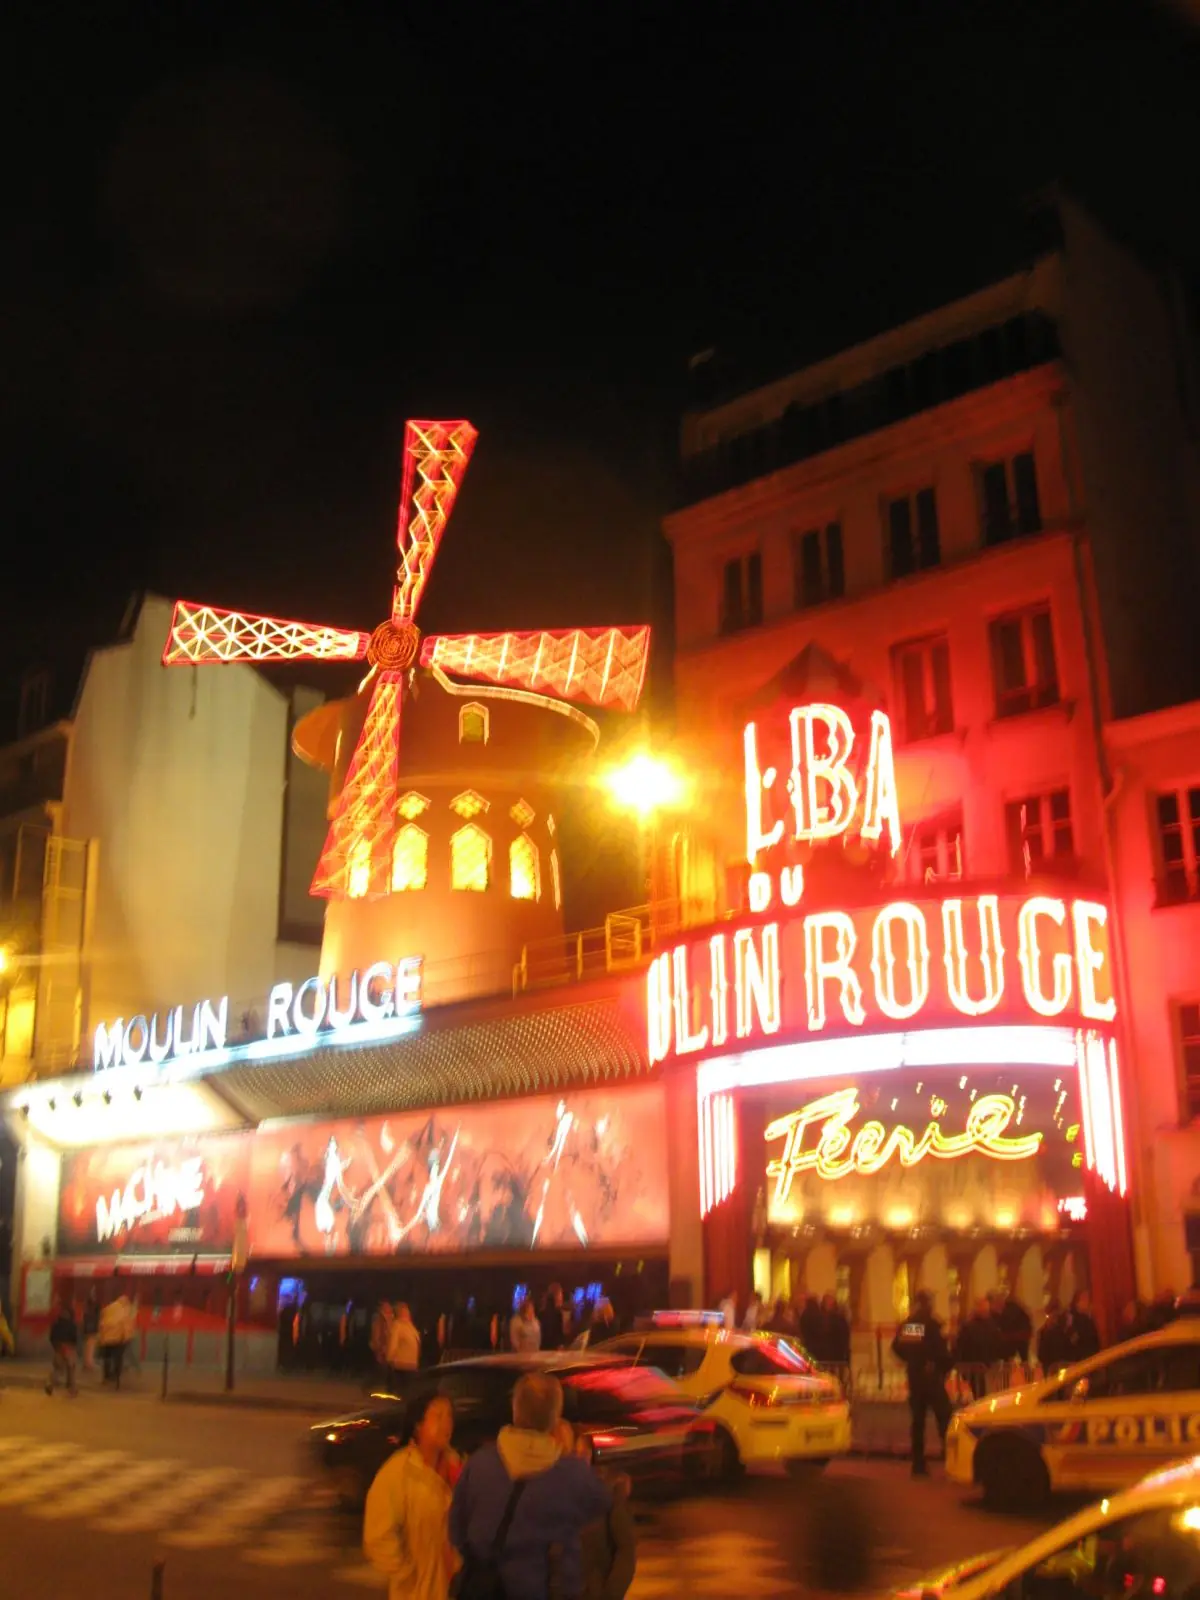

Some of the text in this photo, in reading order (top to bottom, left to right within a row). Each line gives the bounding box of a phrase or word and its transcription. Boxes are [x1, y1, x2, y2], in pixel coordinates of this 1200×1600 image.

[748, 864, 804, 912] DU
[93, 954, 424, 1073] MOULIN ROUGE
[803, 895, 1117, 1032] ROUGE
